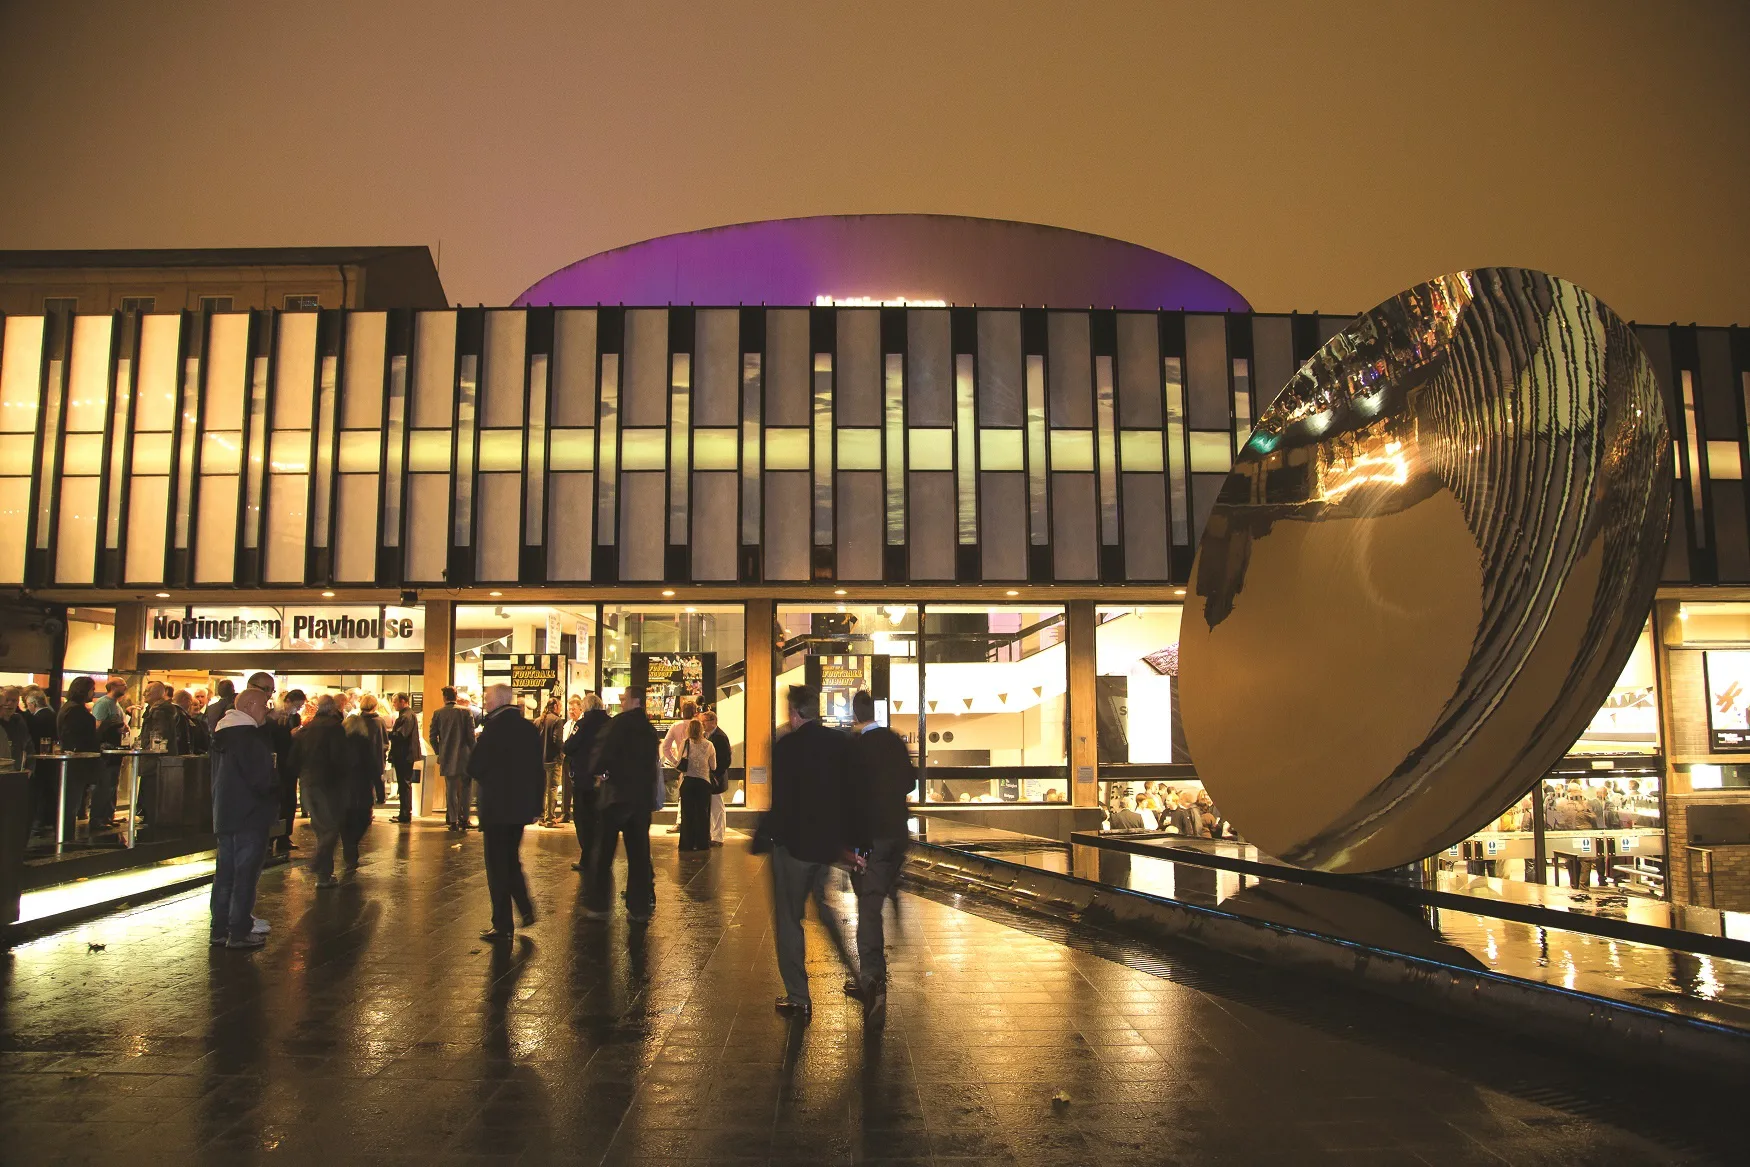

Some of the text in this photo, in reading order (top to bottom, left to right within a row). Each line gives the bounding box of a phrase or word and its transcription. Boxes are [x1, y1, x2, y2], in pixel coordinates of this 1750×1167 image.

[153, 615, 414, 643] Nottingham Playhouse
[512, 670, 556, 678] FOOTBALL
